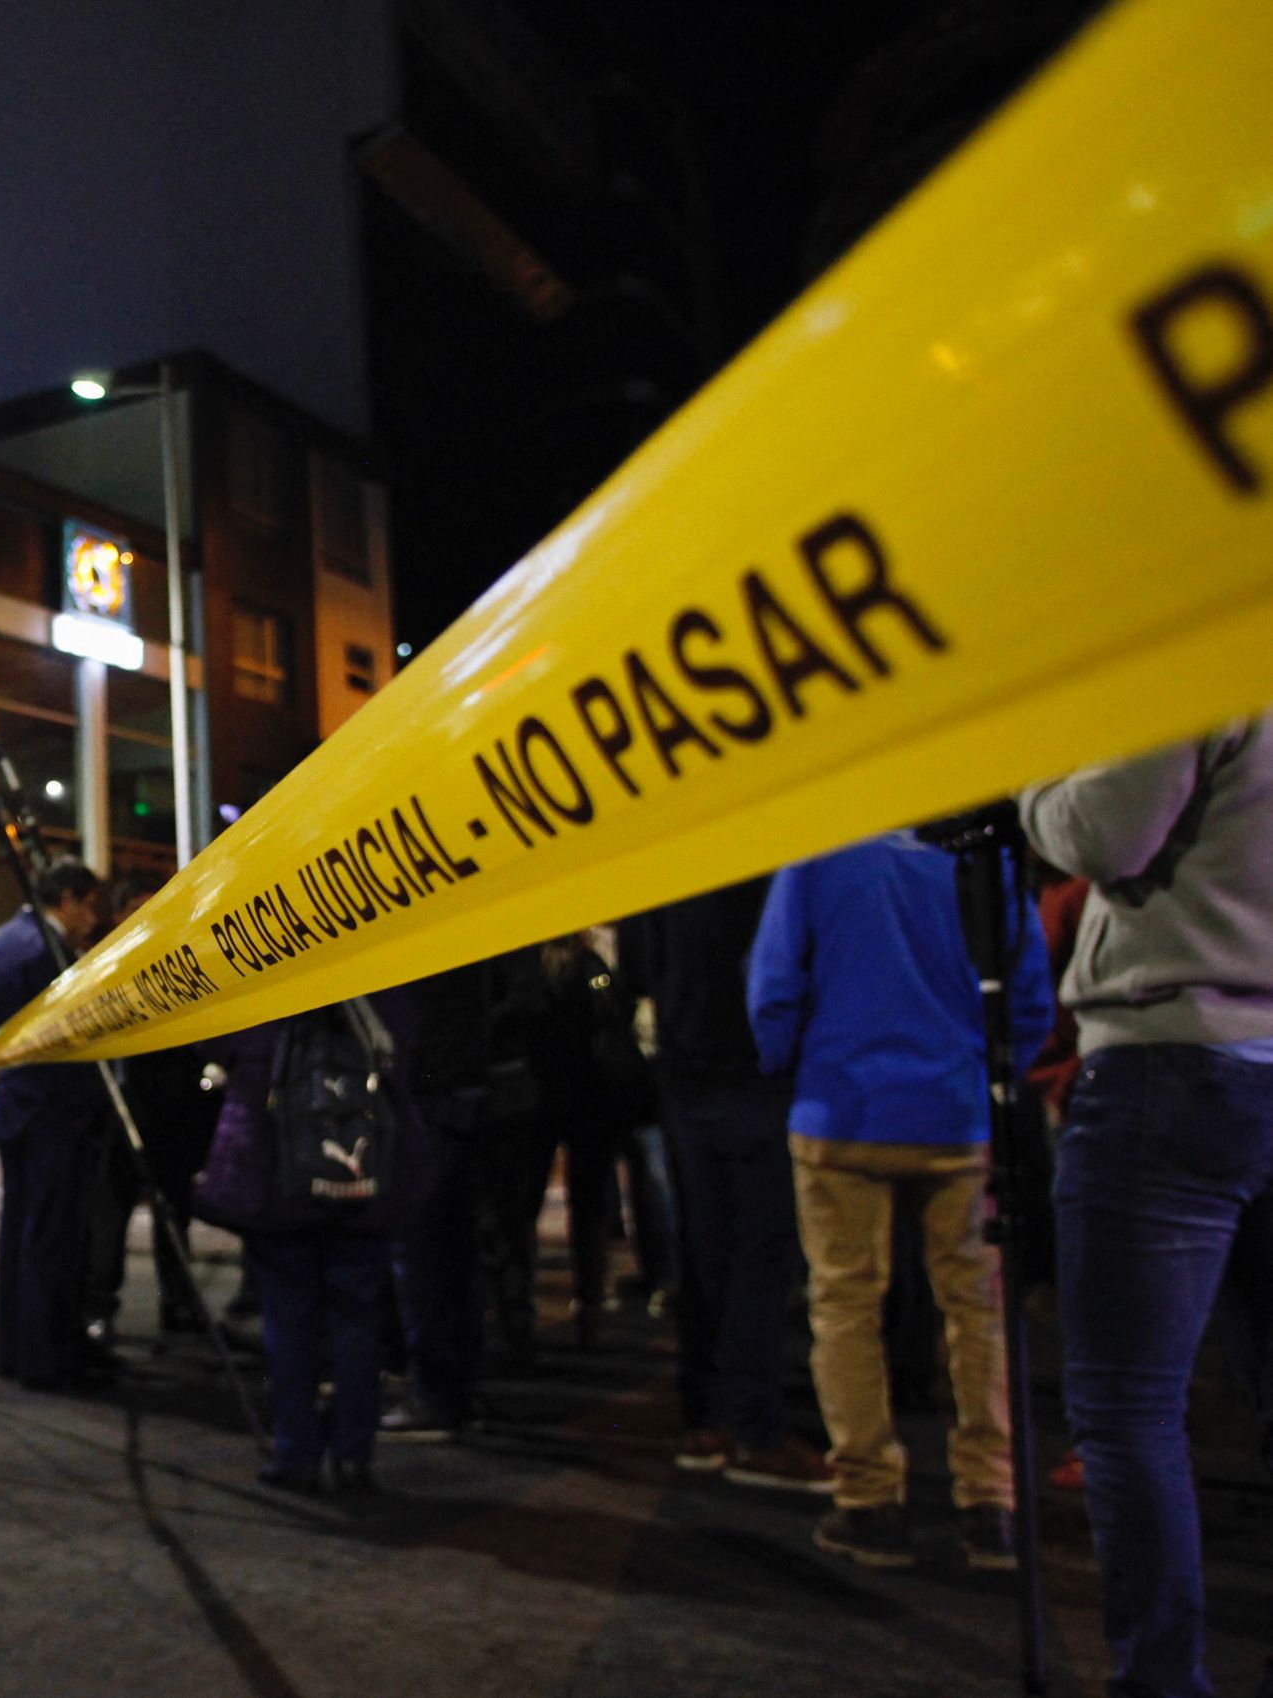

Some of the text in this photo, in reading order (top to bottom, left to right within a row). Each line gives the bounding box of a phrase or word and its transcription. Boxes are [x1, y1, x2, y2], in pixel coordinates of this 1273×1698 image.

[570, 510, 950, 797] PASAR
[473, 716, 594, 848] NO
[297, 795, 480, 938] JUDICIAL
[150, 944, 220, 1007] PASAR
[211, 883, 322, 977] POLICIA
[132, 969, 171, 1014] NO
